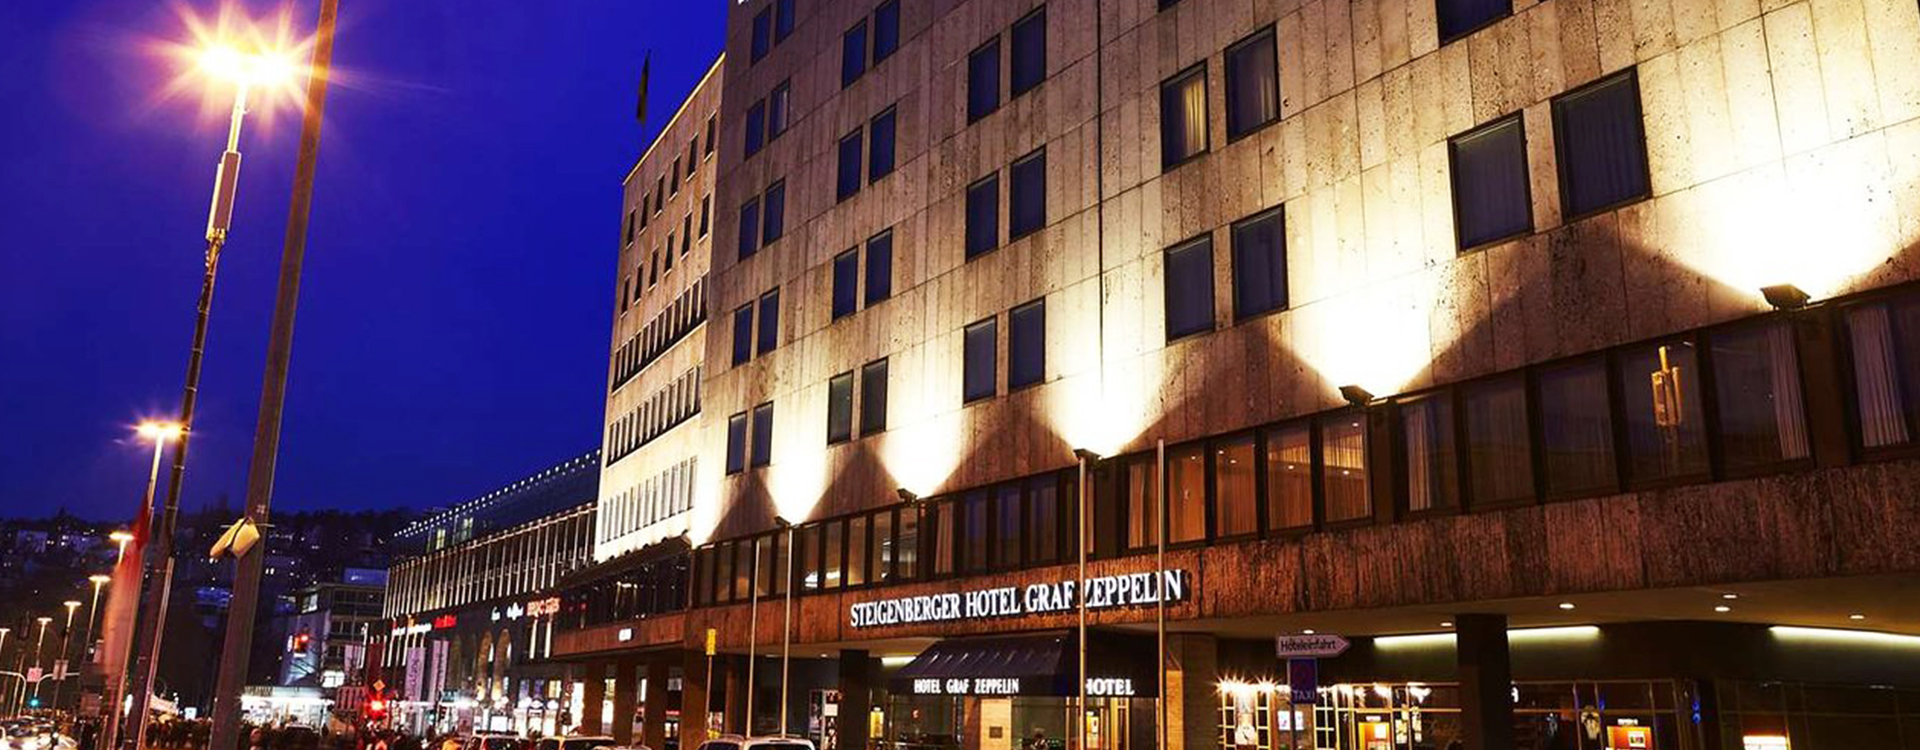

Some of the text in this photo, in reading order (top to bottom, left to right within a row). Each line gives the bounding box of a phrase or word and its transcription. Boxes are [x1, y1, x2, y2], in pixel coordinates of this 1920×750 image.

[851, 593, 961, 627] STEIGENBERGER
[965, 586, 1021, 617] HOTEL
[1025, 580, 1075, 613] GRAF
[914, 678, 1020, 694] HOTEL GRAF ZEPPELIN
[1291, 689, 1316, 701] TAXI
